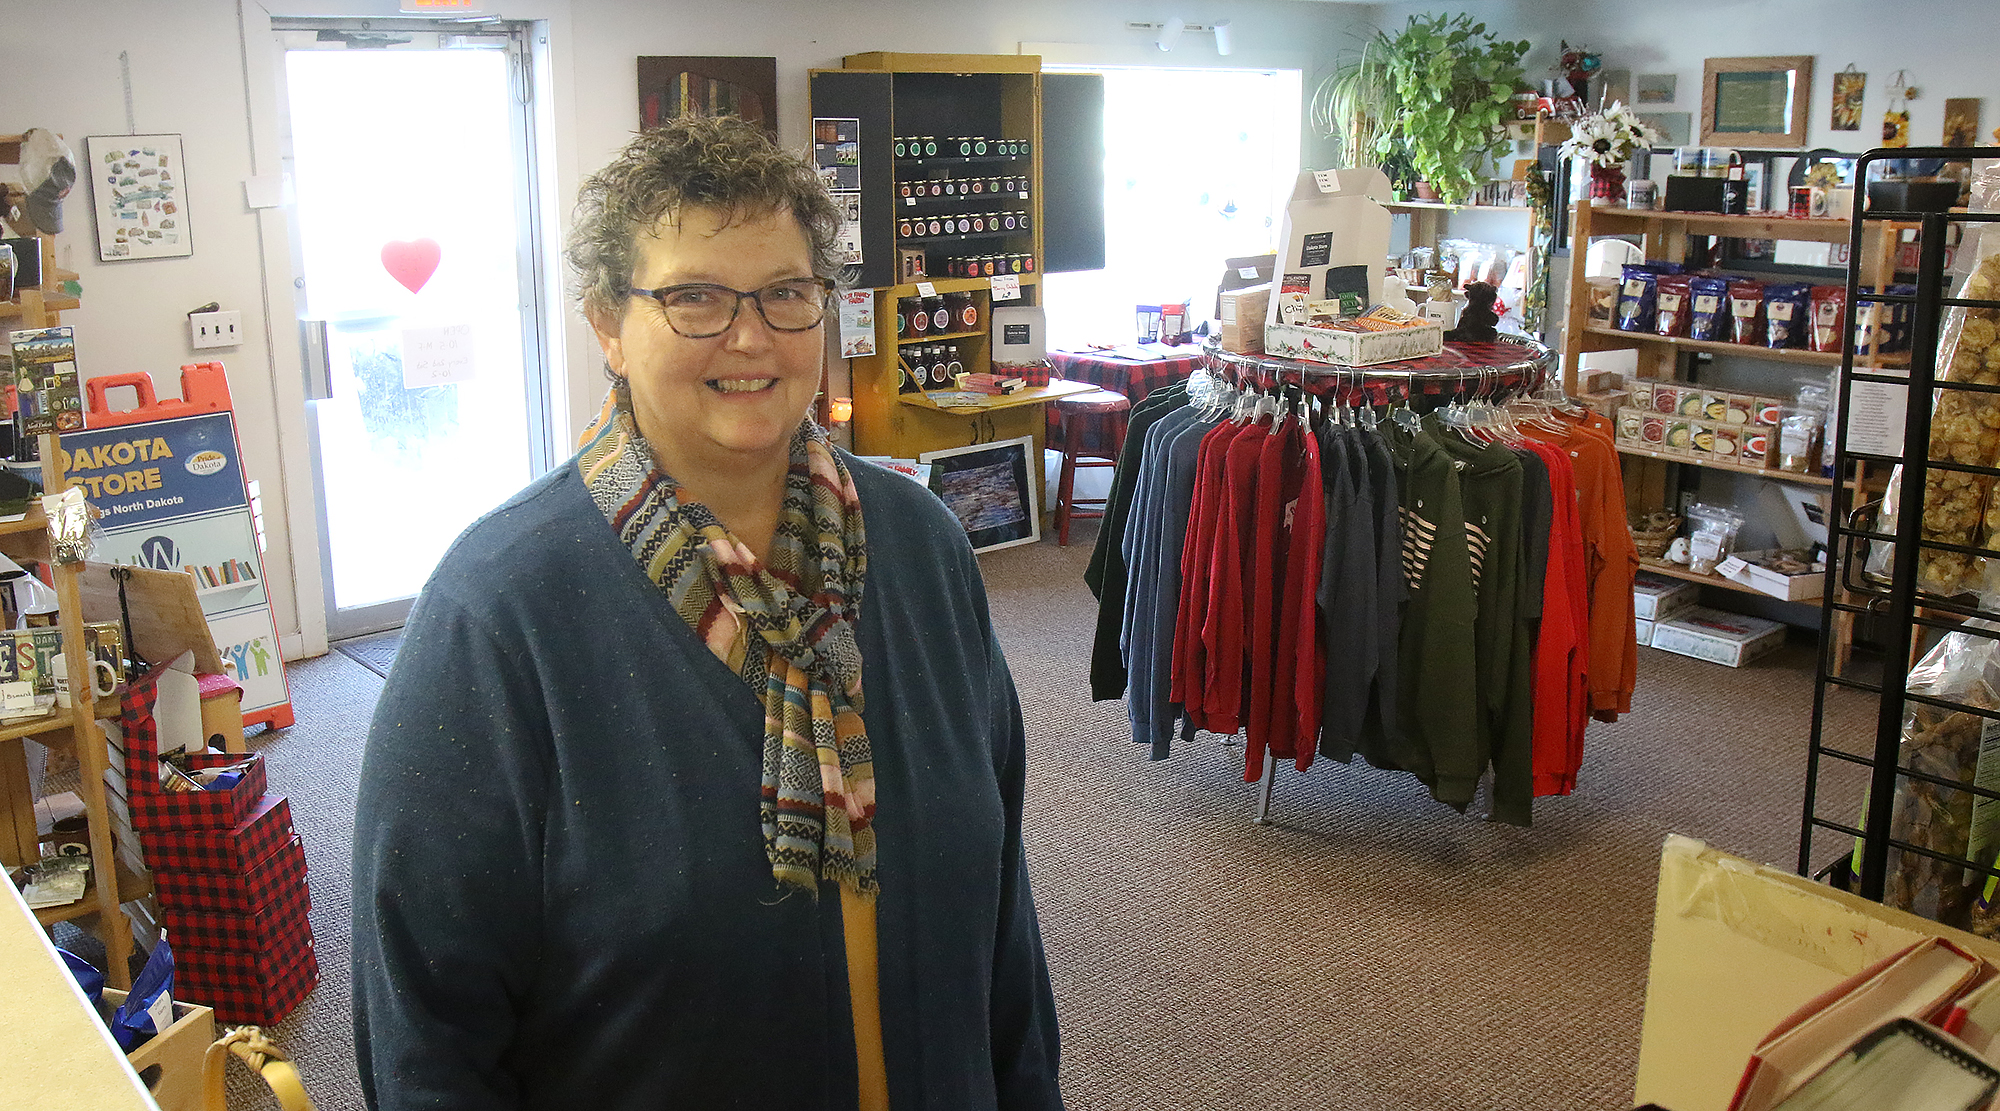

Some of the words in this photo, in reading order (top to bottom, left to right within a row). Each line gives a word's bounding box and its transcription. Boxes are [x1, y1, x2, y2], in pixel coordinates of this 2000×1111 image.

[60, 437, 173, 473] DAKOTA
[192, 461, 222, 471] Dakota
[65, 468, 163, 500] STORE
[113, 502, 144, 514] North
[146, 495, 184, 509] Dakota
